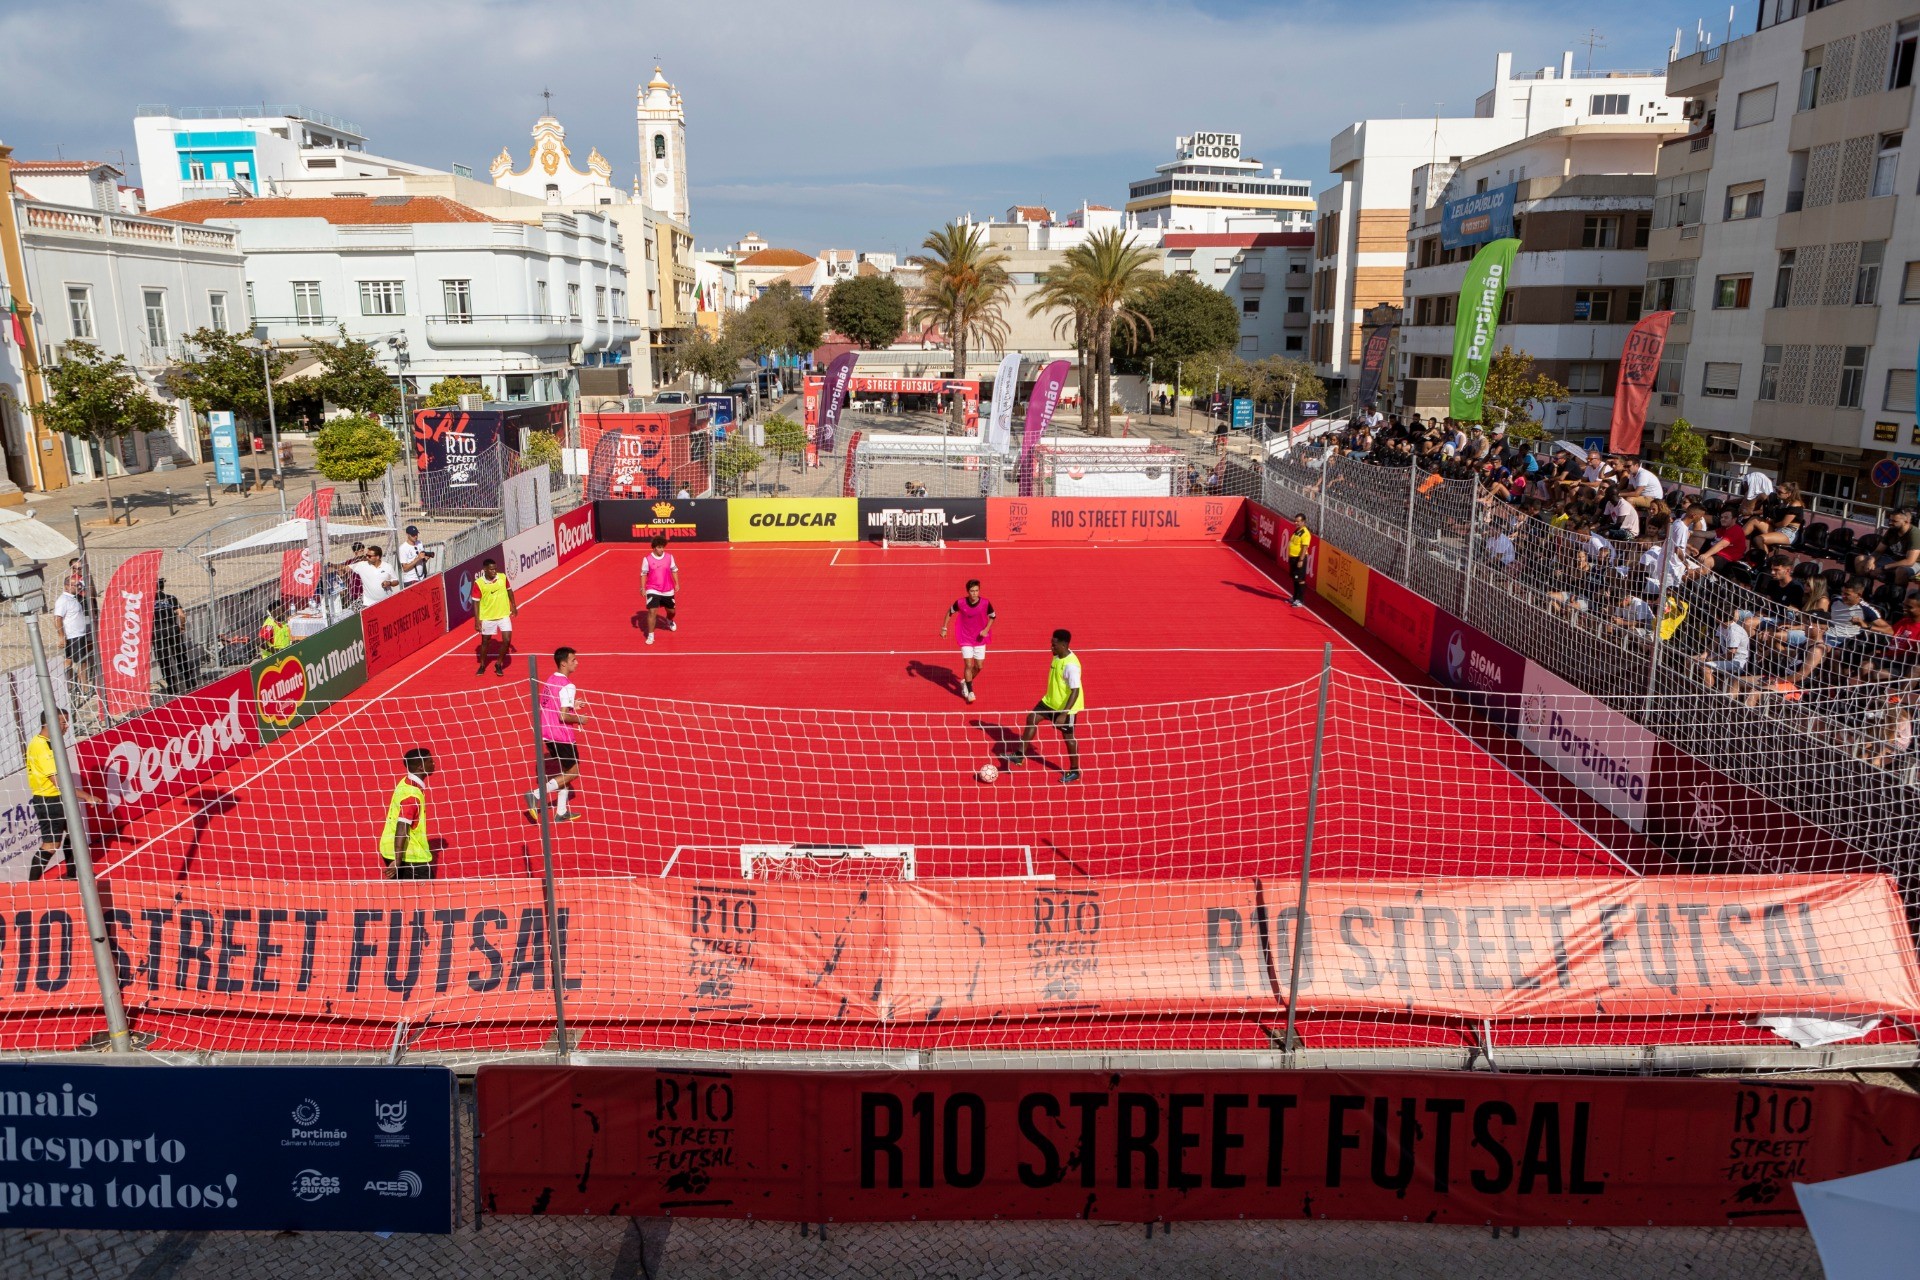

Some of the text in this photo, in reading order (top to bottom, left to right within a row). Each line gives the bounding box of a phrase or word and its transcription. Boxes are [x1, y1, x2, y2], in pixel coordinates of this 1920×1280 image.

[1197, 133, 1239, 146] HOTEL
[1195, 146, 1240, 158] GLOBO
[1451, 193, 1504, 219] LEILÃO PÚBLICO
[1467, 264, 1503, 361] Portimão
[1629, 333, 1660, 355] R10
[1624, 361, 1655, 372] FUTSAL
[826, 365, 849, 419] Portimão
[867, 379, 897, 391] STREET
[901, 380, 932, 391] FUTSAL
[414, 410, 470, 441] SAL
[446, 435, 476, 454] R10
[446, 454, 477, 464] STREET
[446, 462, 478, 472] FUTSAL
[614, 457, 642, 467] TREET
[749, 512, 838, 527] GOLDCAR
[1010, 505, 1027, 515] R10
[1052, 510, 1180, 528] R10 STREET FUTSAL
[1205, 504, 1223, 515] R10
[558, 510, 593, 557] Record
[1259, 515, 1275, 535] Digital
[520, 541, 555, 572] Portimão
[113, 589, 144, 678] Record
[383, 623, 394, 642] R10
[394, 613, 411, 636] STREET
[412, 604, 430, 626] FUTSAL
[306, 639, 365, 691] Del Monte
[1470, 649, 1502, 684] SIGMA
[260, 672, 304, 706] Del Monte
[1467, 666, 1494, 697] STARS
[104, 689, 245, 814] Record
[1548, 710, 1644, 802] Portimão
[692, 896, 758, 935] R10
[1034, 897, 1100, 935] R10
[0, 909, 582, 993] 10 STREET FUTSAL
[689, 938, 758, 957] STREET
[1030, 938, 1100, 959] STREET
[1207, 902, 1845, 992] R10 STREET FUTSAL
[688, 957, 757, 977] FUTSAL
[1033, 957, 1100, 979] FUTSAL
[0, 1083, 99, 1117] mais
[655, 1078, 734, 1122] R10
[1734, 1090, 1812, 1134] R10
[281, 1139, 341, 1148] Câmara Municipal
[291, 1128, 347, 1139] Portimão
[653, 1125, 735, 1148] STREET
[861, 1092, 1604, 1195] R10 STREET FUTSAL
[0, 1127, 186, 1169] desporto
[653, 1147, 734, 1170] FUTSAL
[1729, 1138, 1808, 1160] STREET
[1727, 1158, 1806, 1180] FUTSAL
[0, 1173, 239, 1213] para todos!
[300, 1176, 340, 1187] aces
[300, 1186, 341, 1196] europe
[364, 1181, 408, 1191] ACES
